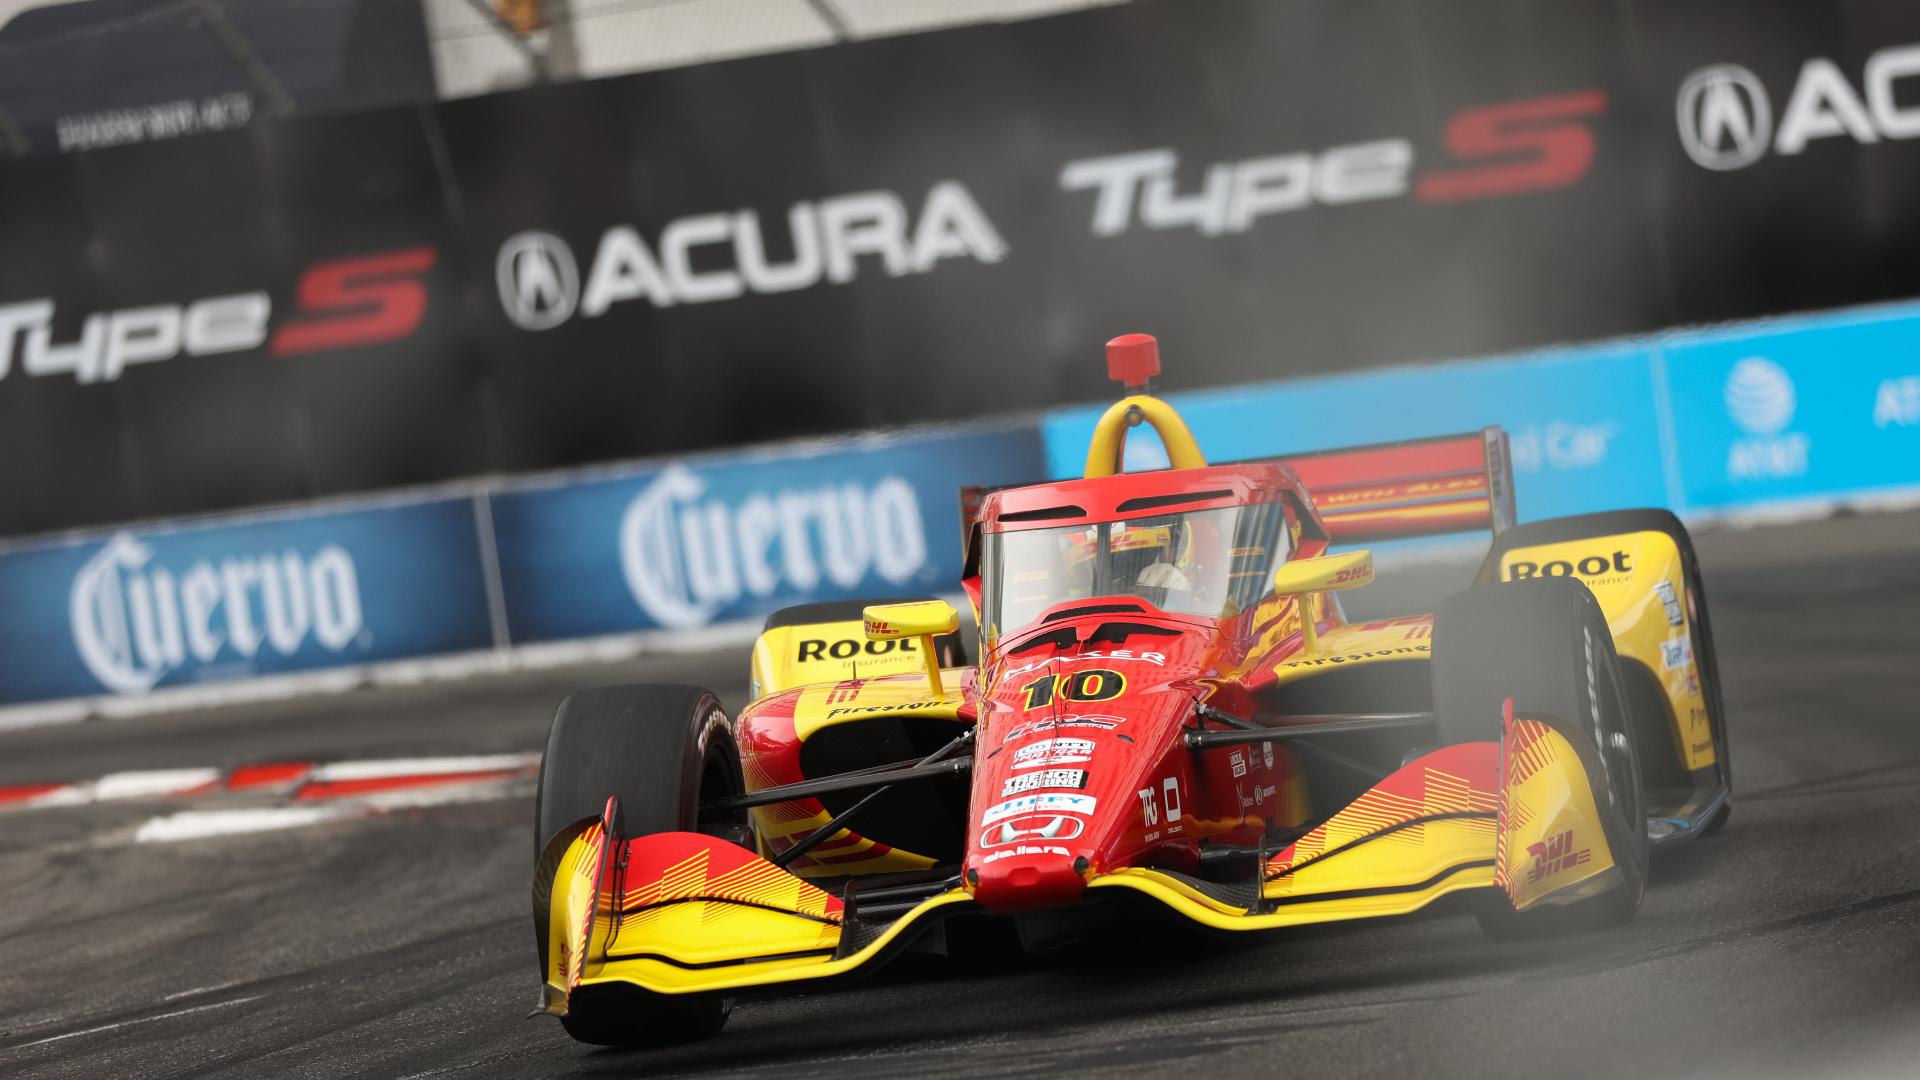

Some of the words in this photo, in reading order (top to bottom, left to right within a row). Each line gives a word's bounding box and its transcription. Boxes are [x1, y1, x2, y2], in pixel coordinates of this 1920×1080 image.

[1417, 92, 1608, 202] S
[580, 178, 1010, 318] ACURA
[272, 246, 437, 358] S
[619, 462, 928, 630] Cuervo
[1509, 549, 1634, 580] Root
[1335, 563, 1371, 584] DHL
[68, 530, 364, 695] Cuervo
[863, 621, 893, 634] DHL
[1282, 645, 1430, 668] Firestone
[1020, 669, 1127, 712] 10
[827, 700, 958, 720] Firestone
[991, 796, 1085, 815] JIFFY
[983, 845, 1071, 864] dallara
[1526, 829, 1580, 881] DHL
